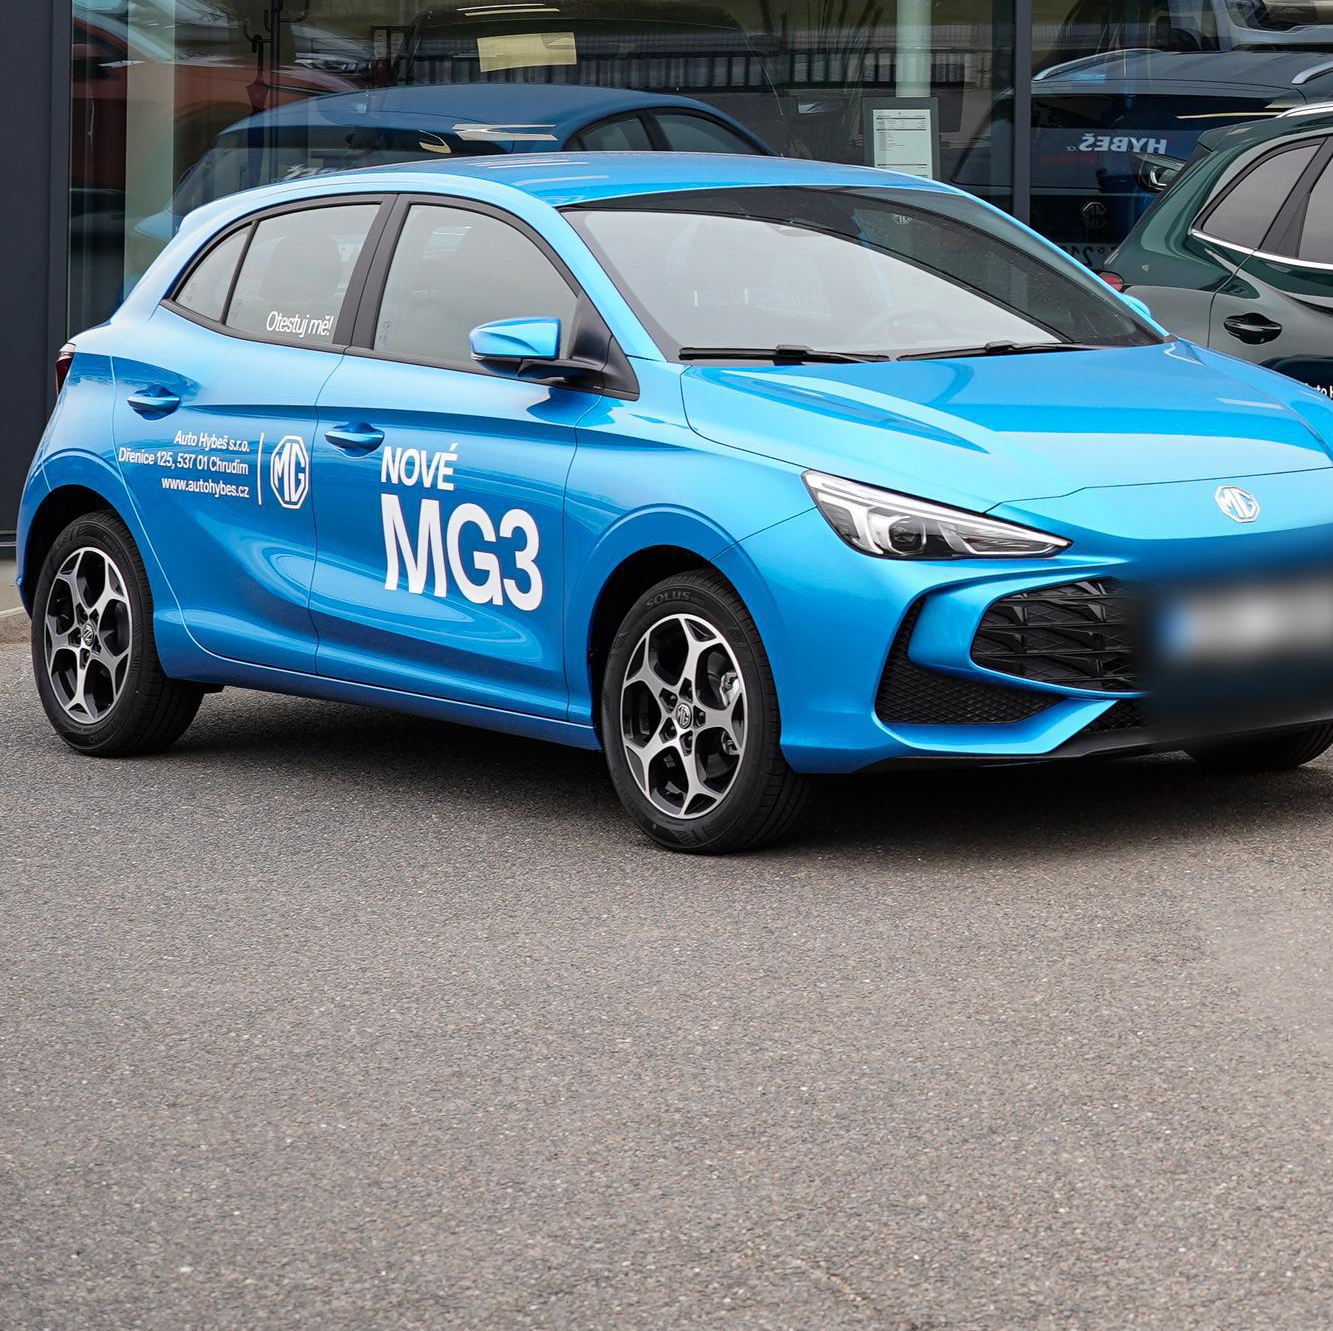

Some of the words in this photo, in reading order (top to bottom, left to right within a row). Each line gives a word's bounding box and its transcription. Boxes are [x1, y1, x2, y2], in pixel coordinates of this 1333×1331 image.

[266, 311, 309, 338] Otestuj
[308, 314, 334, 336] mě!
[174, 430, 198, 446] Auto
[199, 432, 228, 452] Hybeš
[228, 438, 250, 452] s.r.o.
[118, 447, 155, 465] Dřenice
[156, 452, 176, 470] 125,
[177, 454, 195, 469] 537
[196, 456, 209, 471] 01
[209, 457, 249, 475] Chrudim
[273, 443, 306, 503] MG
[380, 443, 458, 492] NOVÉ
[161, 477, 250, 499] www.autohybes.cz
[1218, 488, 1257, 519] MG
[381, 493, 543, 612] MG3
